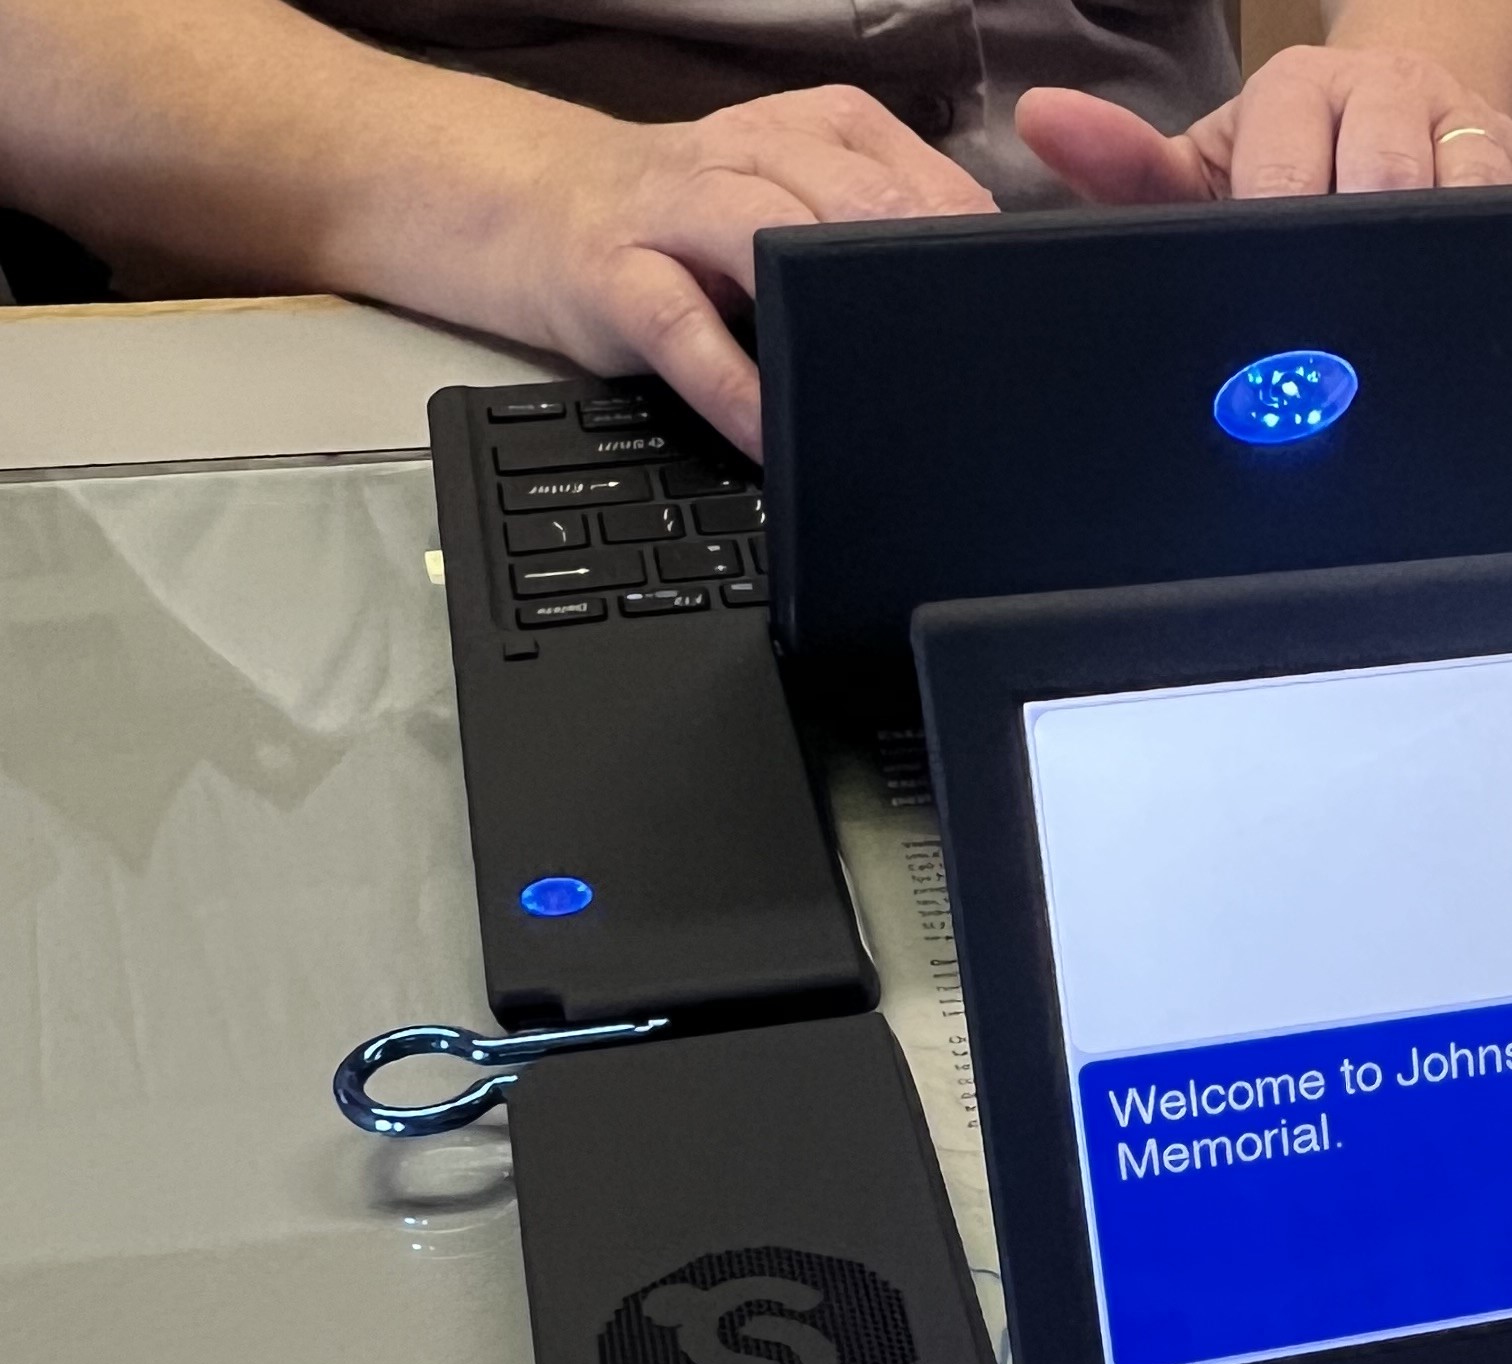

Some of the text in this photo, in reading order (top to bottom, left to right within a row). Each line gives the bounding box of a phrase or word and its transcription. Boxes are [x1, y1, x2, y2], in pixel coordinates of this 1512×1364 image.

[1108, 1069, 1326, 1129] Welcome
[1339, 1057, 1383, 1096] to
[1116, 1112, 1344, 1182] Memorial.
